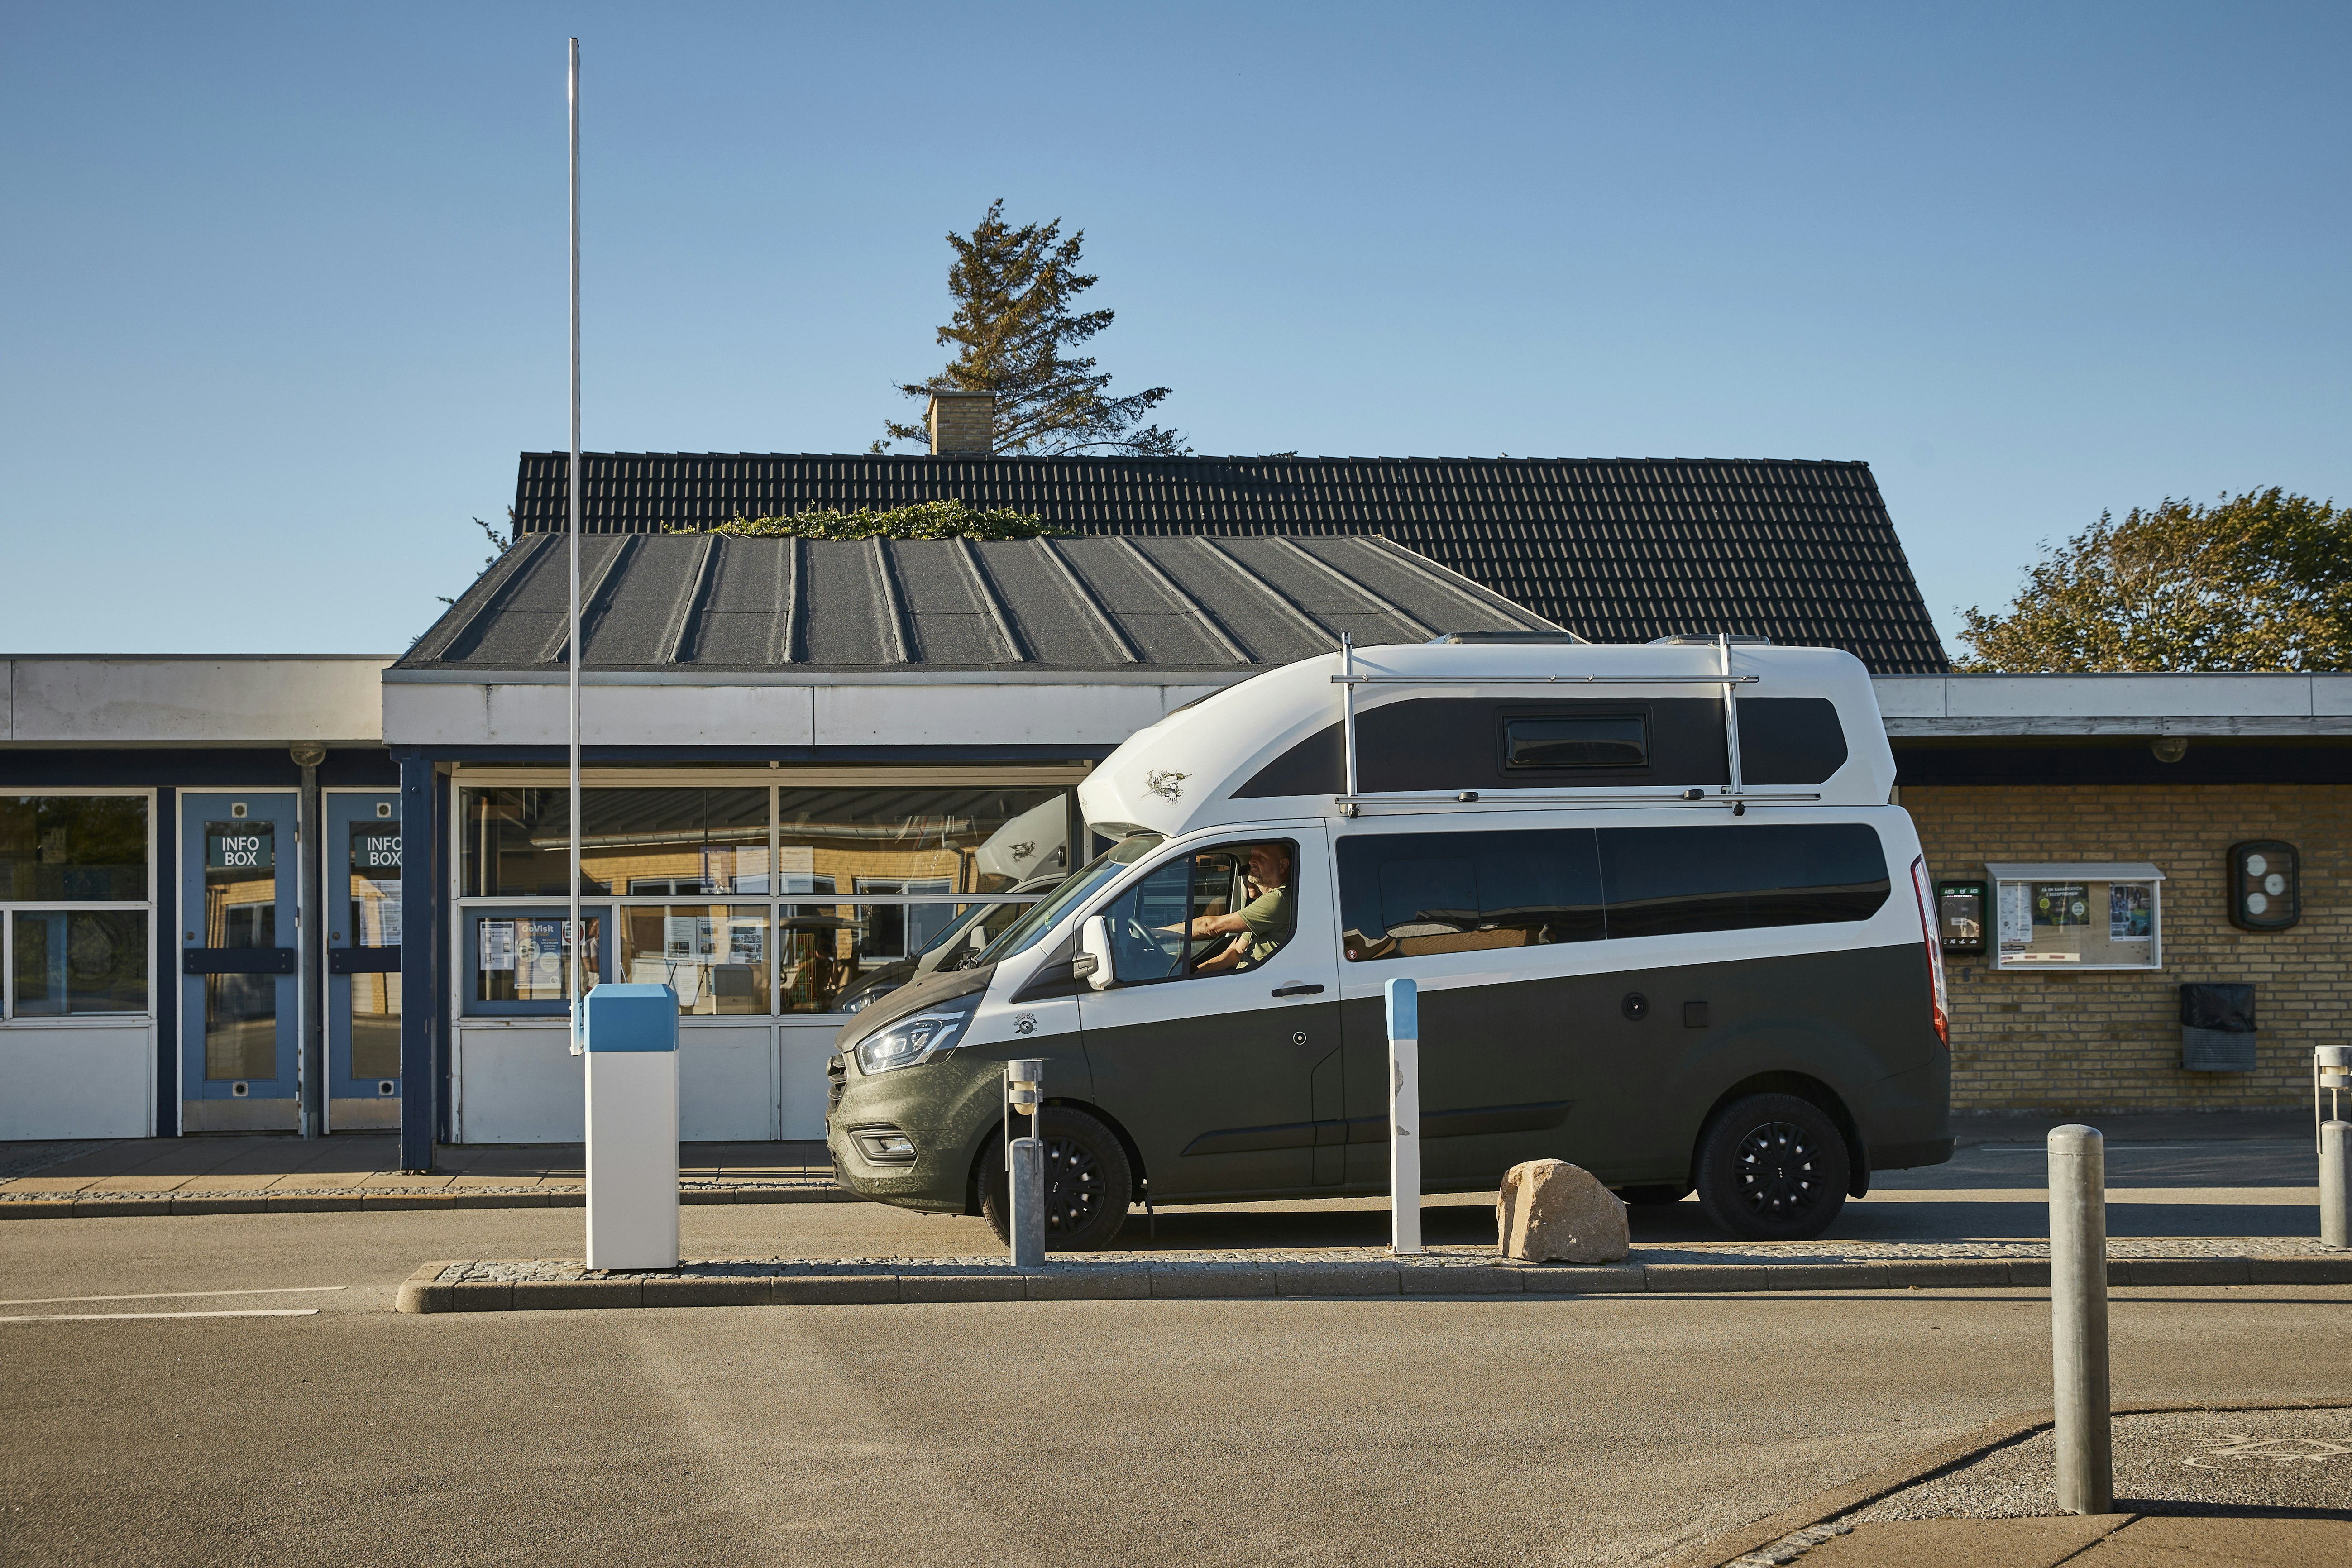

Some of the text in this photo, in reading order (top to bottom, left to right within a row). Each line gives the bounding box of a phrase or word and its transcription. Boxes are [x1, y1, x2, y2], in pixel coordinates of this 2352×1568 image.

[222, 837, 259, 851] INFO
[368, 837, 401, 851] INFO
[225, 851, 257, 865] BOX
[370, 851, 401, 865] BOX
